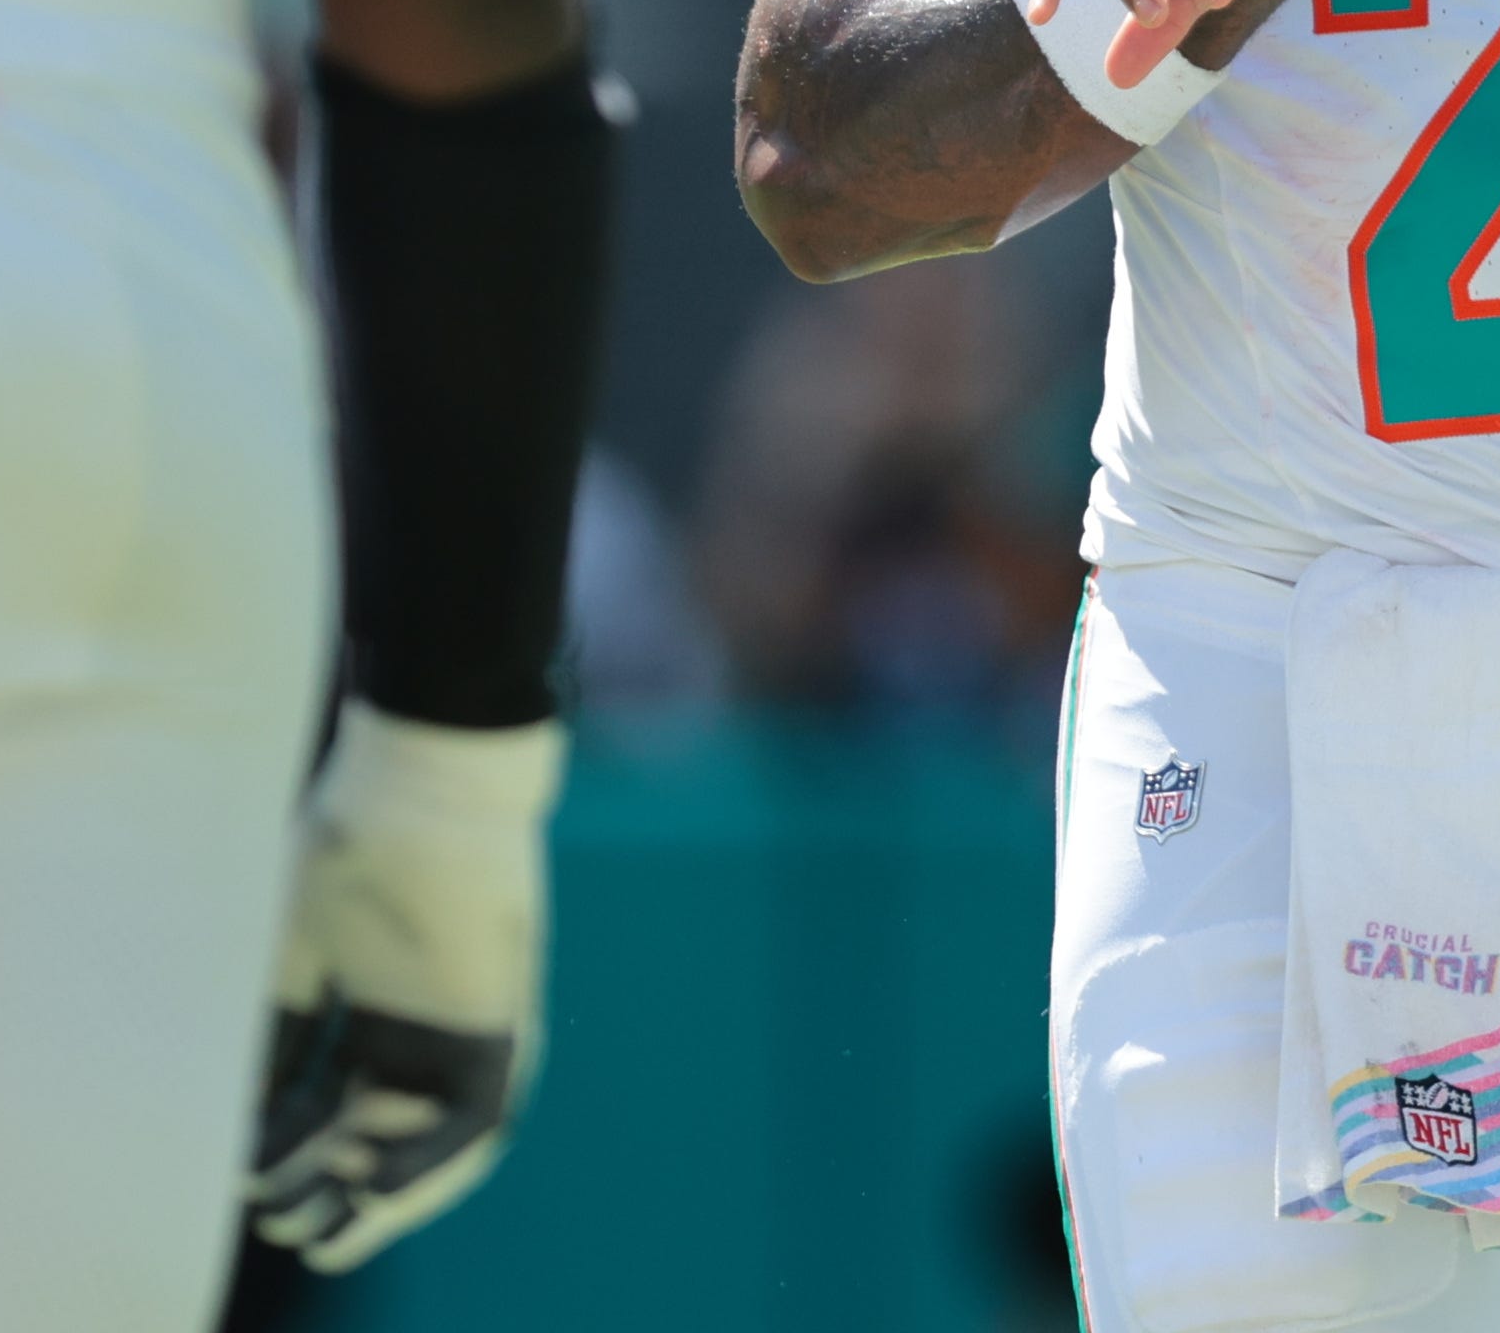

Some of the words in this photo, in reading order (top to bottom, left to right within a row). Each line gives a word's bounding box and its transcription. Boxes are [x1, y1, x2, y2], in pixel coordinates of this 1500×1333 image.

[1143, 792, 1188, 826] NFL
[1365, 921, 1473, 953] CRUCIAL
[1344, 939, 1500, 995] CATCH
[1411, 1112, 1471, 1156] NFL
